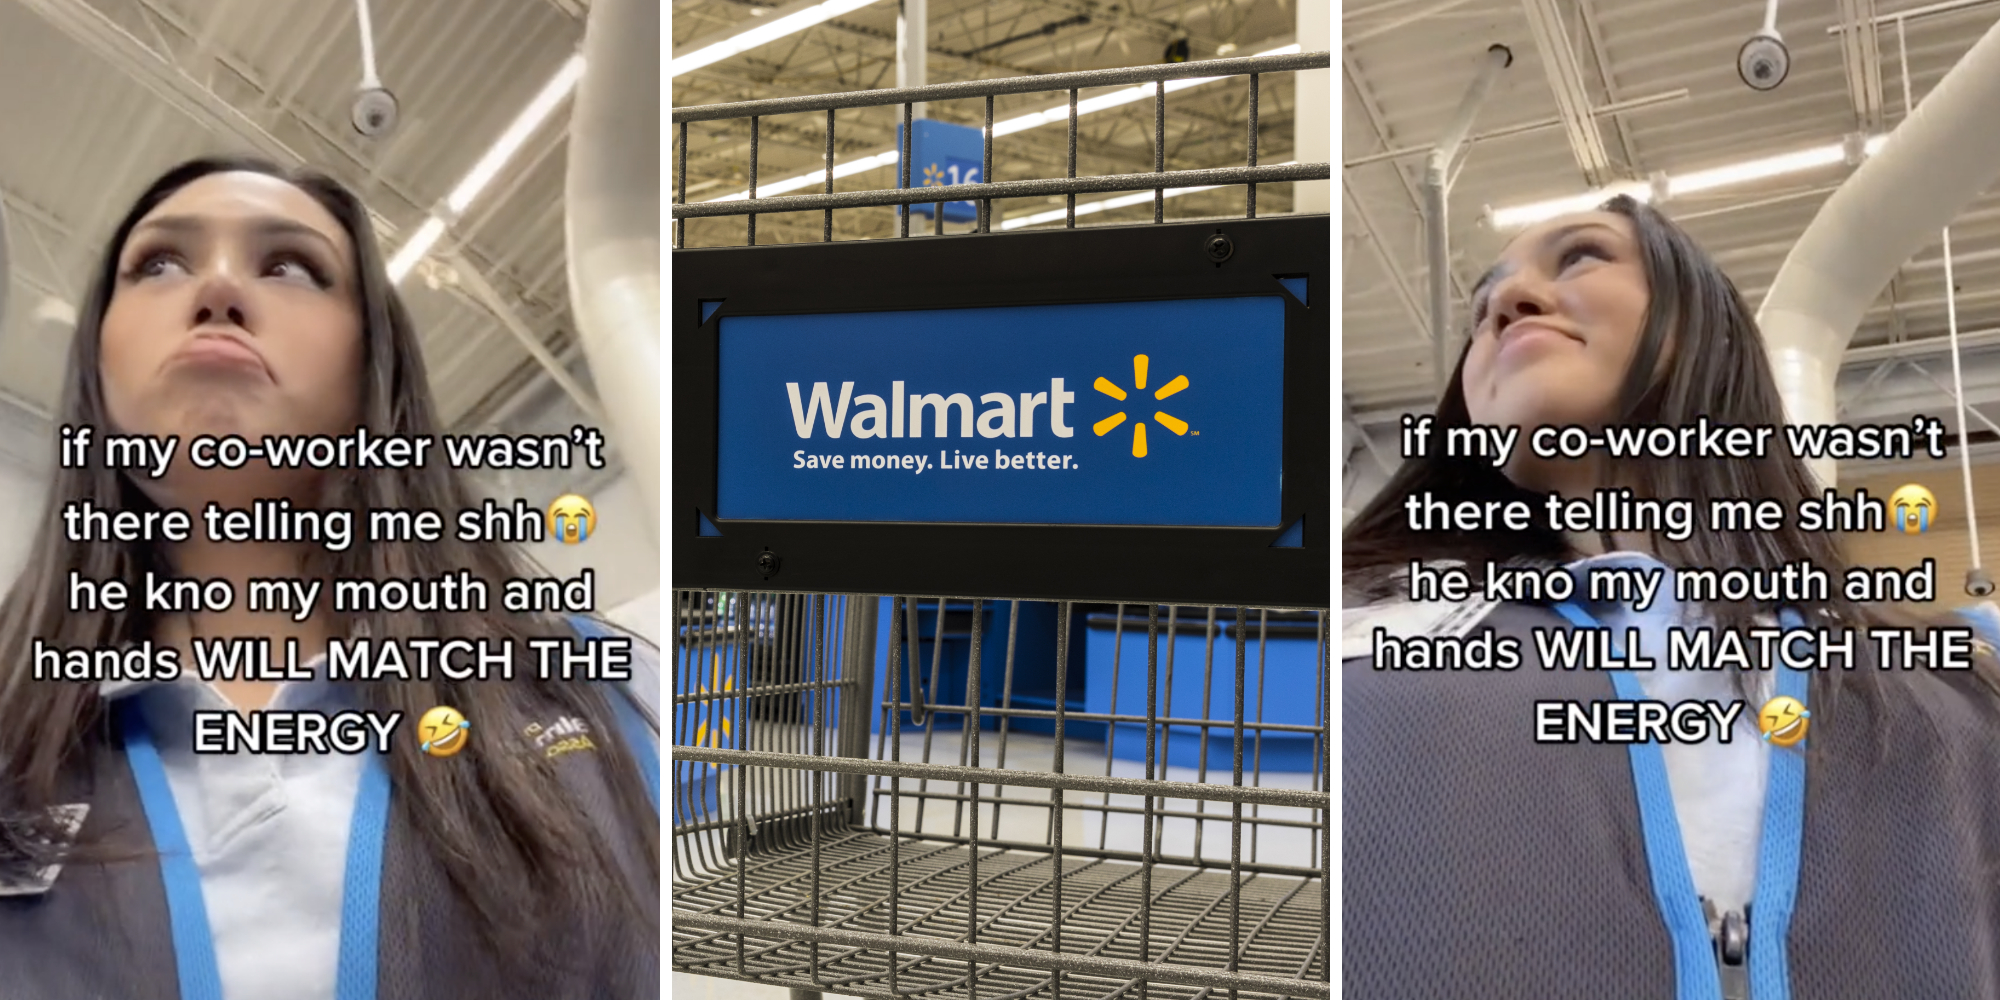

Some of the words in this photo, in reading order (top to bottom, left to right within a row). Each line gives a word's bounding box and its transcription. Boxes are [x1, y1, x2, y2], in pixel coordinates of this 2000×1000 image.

[947, 165, 979, 206] 16
[785, 377, 1075, 439] Walmart
[793, 449, 845, 470] Save
[850, 453, 933, 474] money.
[941, 449, 989, 470] Live
[995, 449, 1079, 470] better.
